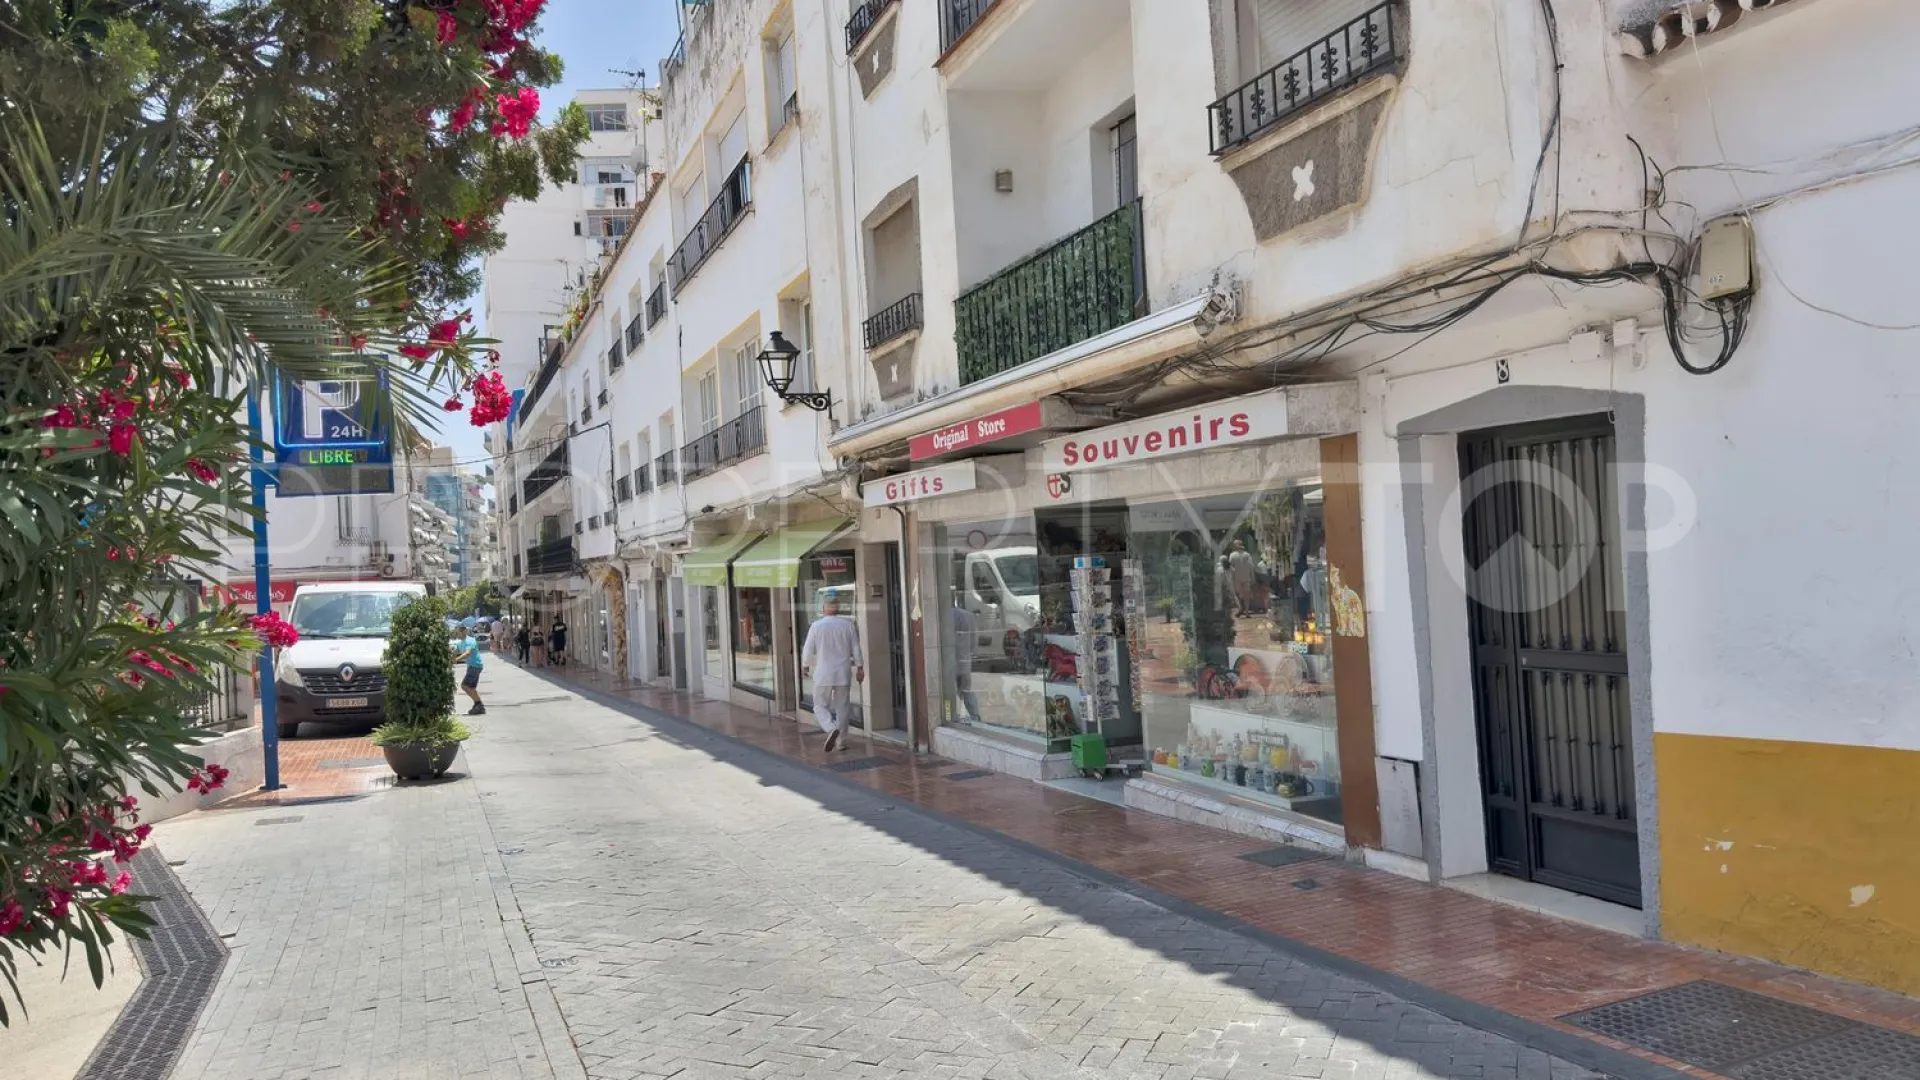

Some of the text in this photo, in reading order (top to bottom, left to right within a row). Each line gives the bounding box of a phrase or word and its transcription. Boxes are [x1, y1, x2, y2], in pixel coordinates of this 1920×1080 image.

[1497, 359, 1509, 382] 8
[302, 378, 360, 438] P
[331, 425, 364, 438] 24H
[932, 417, 1006, 450] Original Store
[1063, 412, 1250, 467] Souvenirs
[308, 449, 354, 465] LIBRE
[885, 475, 944, 500] Gifts
